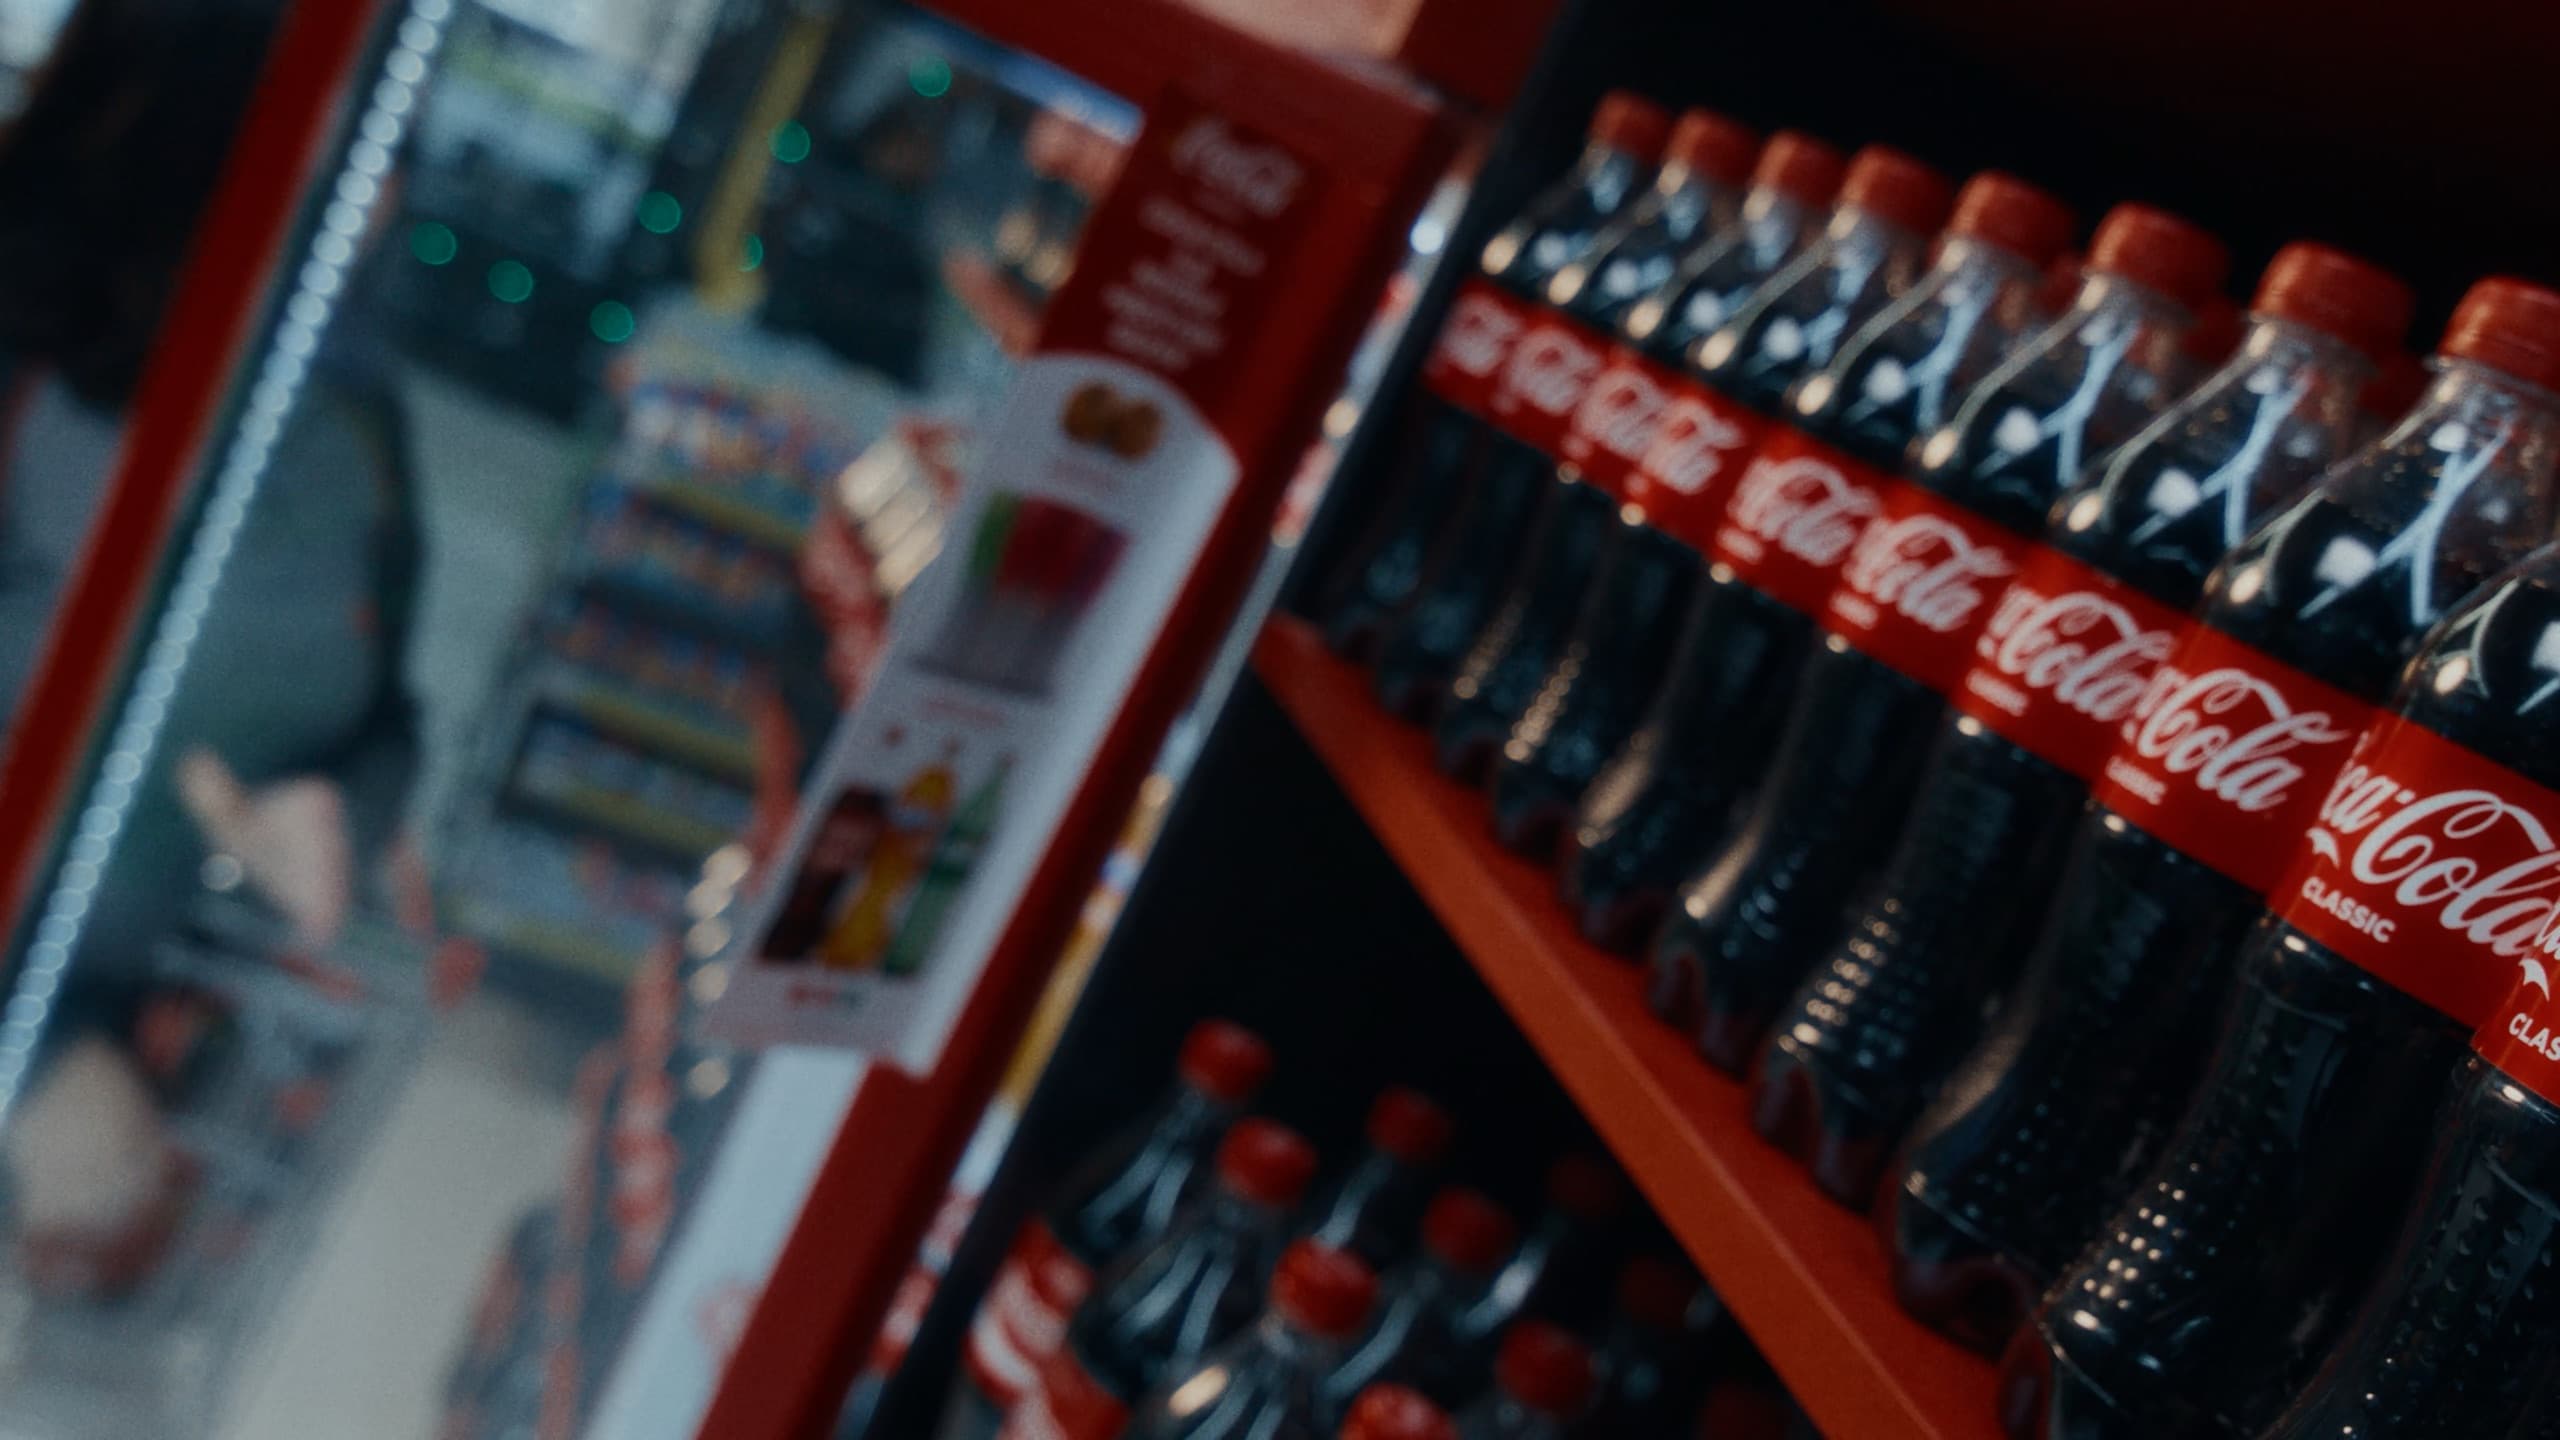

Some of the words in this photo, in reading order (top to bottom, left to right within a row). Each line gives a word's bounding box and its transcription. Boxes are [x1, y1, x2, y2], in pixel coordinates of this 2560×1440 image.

[1985, 588, 2180, 721] Cola
[2306, 730, 2560, 956] ca-Cola
[2301, 876, 2397, 943] CLASSIC
[2508, 1012, 2560, 1061] CLAS
